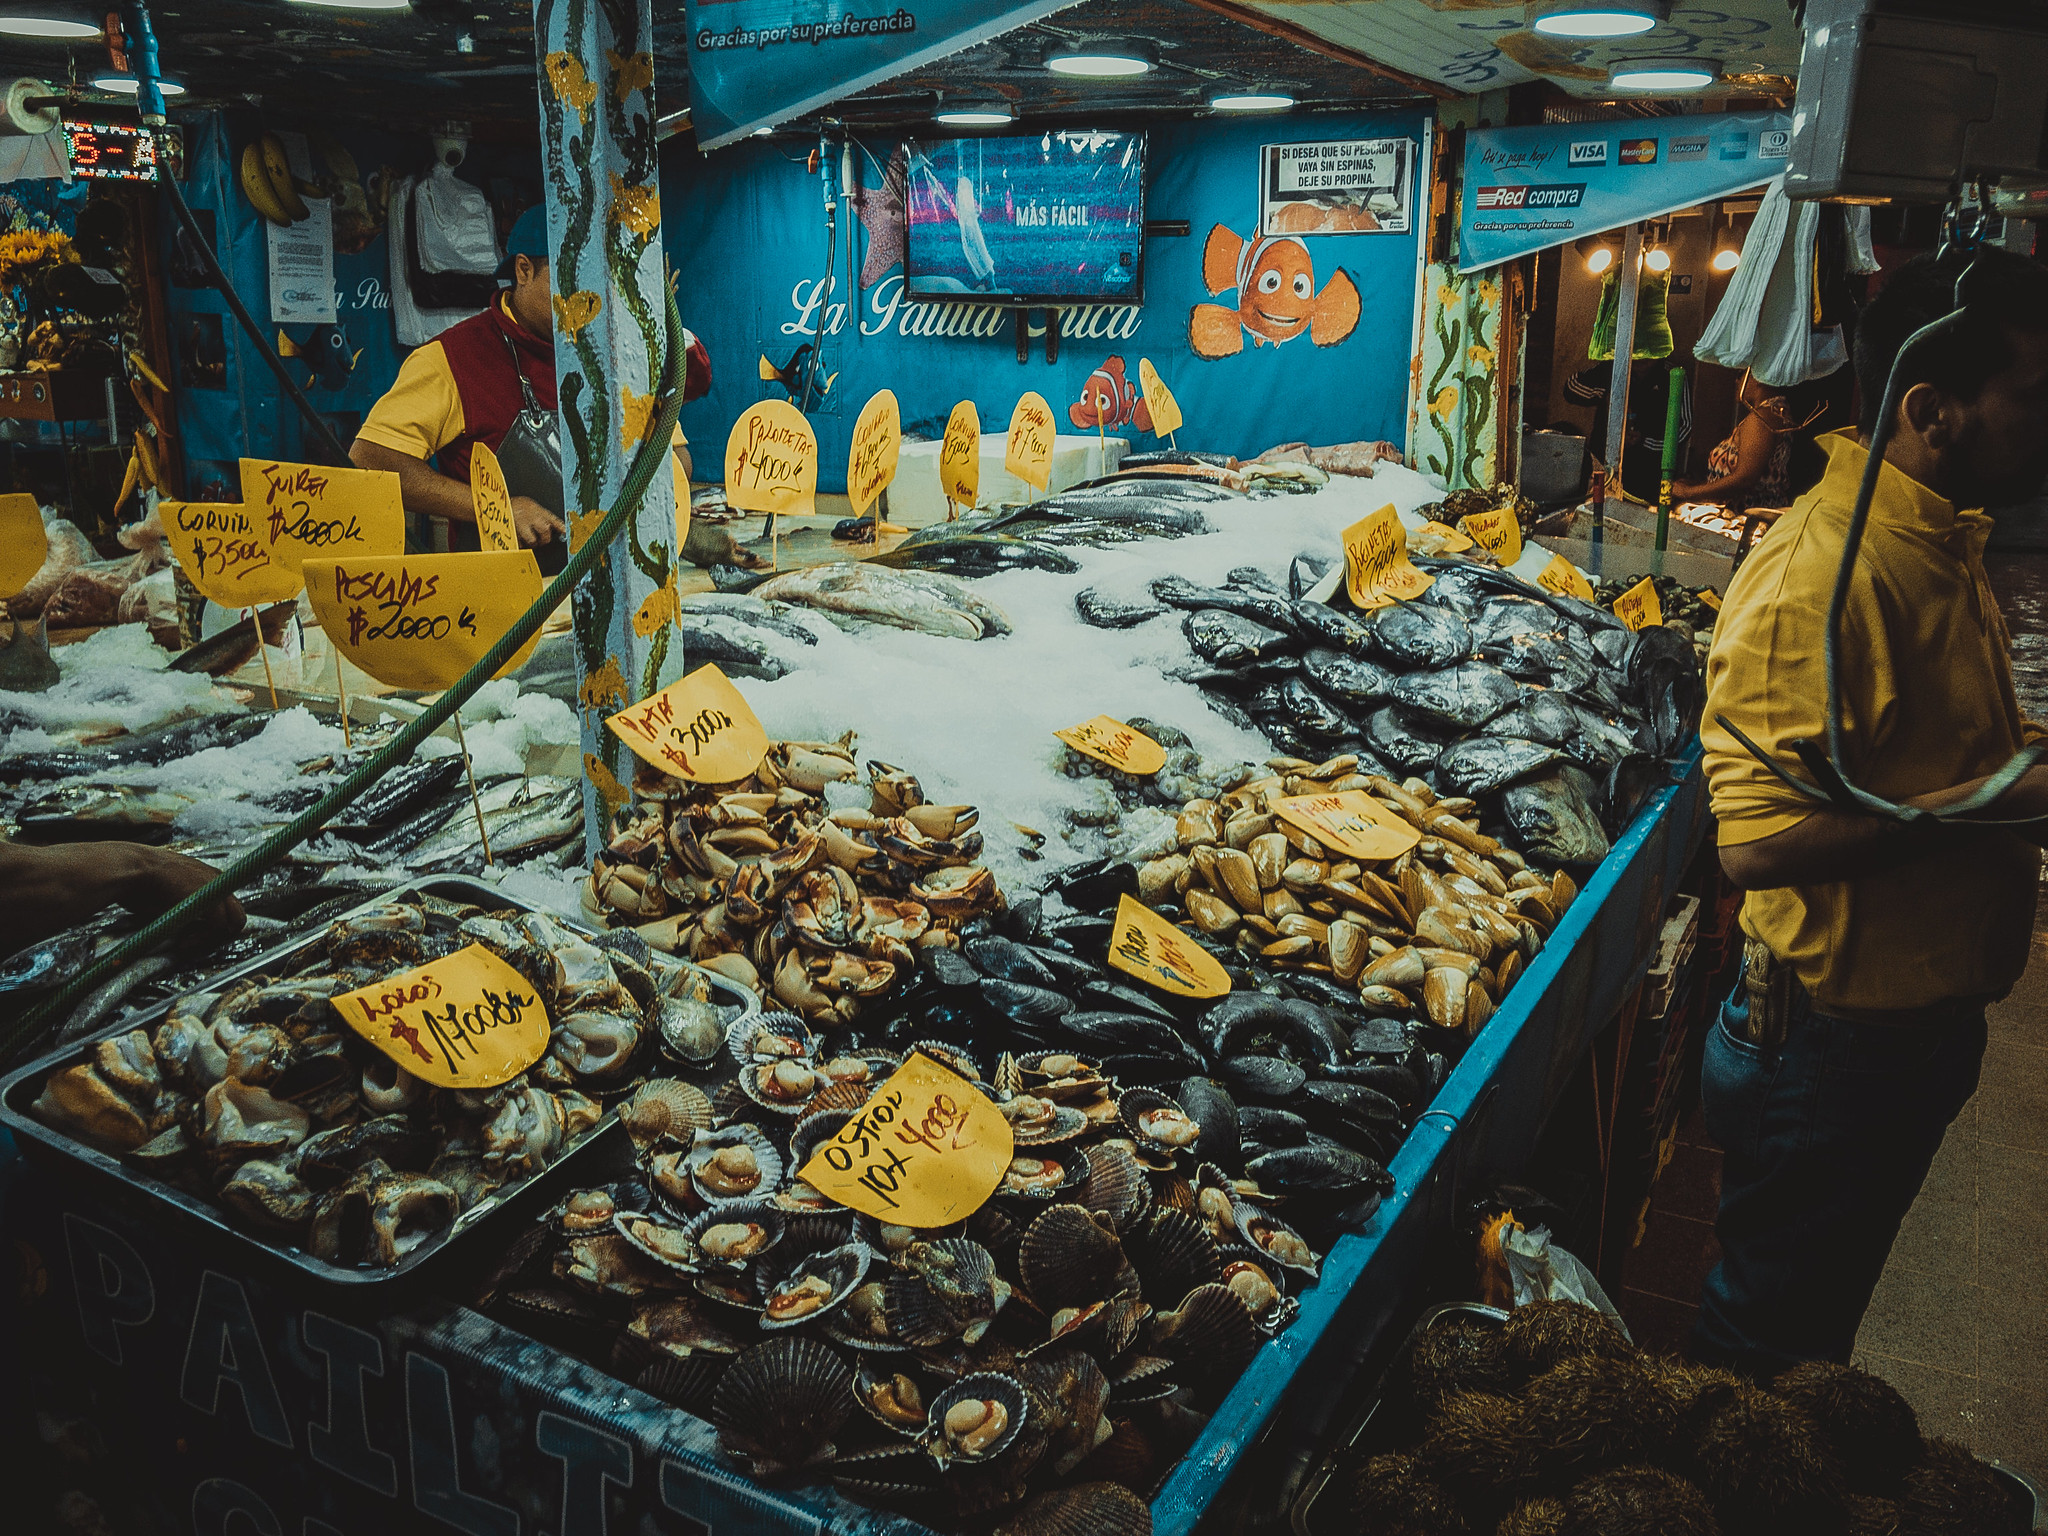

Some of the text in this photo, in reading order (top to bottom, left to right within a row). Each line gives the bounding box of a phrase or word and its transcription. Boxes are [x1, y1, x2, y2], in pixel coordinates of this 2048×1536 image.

[698, 11, 914, 49] Gracias por su preferencia
[1282, 142, 1395, 159] SI DESEA QUE SU PESCADO
[1574, 144, 1606, 159] VISA
[1621, 148, 1655, 157] MasterCard
[1298, 159, 1377, 173] VAYA SIN ESPINAS,
[1298, 174, 1375, 187] DEJE SU PROPINA.
[1494, 187, 1580, 208] Red compra
[1474, 222, 1502, 231] Gracias
[1503, 223, 1516, 231] por
[1528, 219, 1574, 232] preferencia
[780, 275, 847, 336] La
[177, 505, 253, 535] CORVIN
